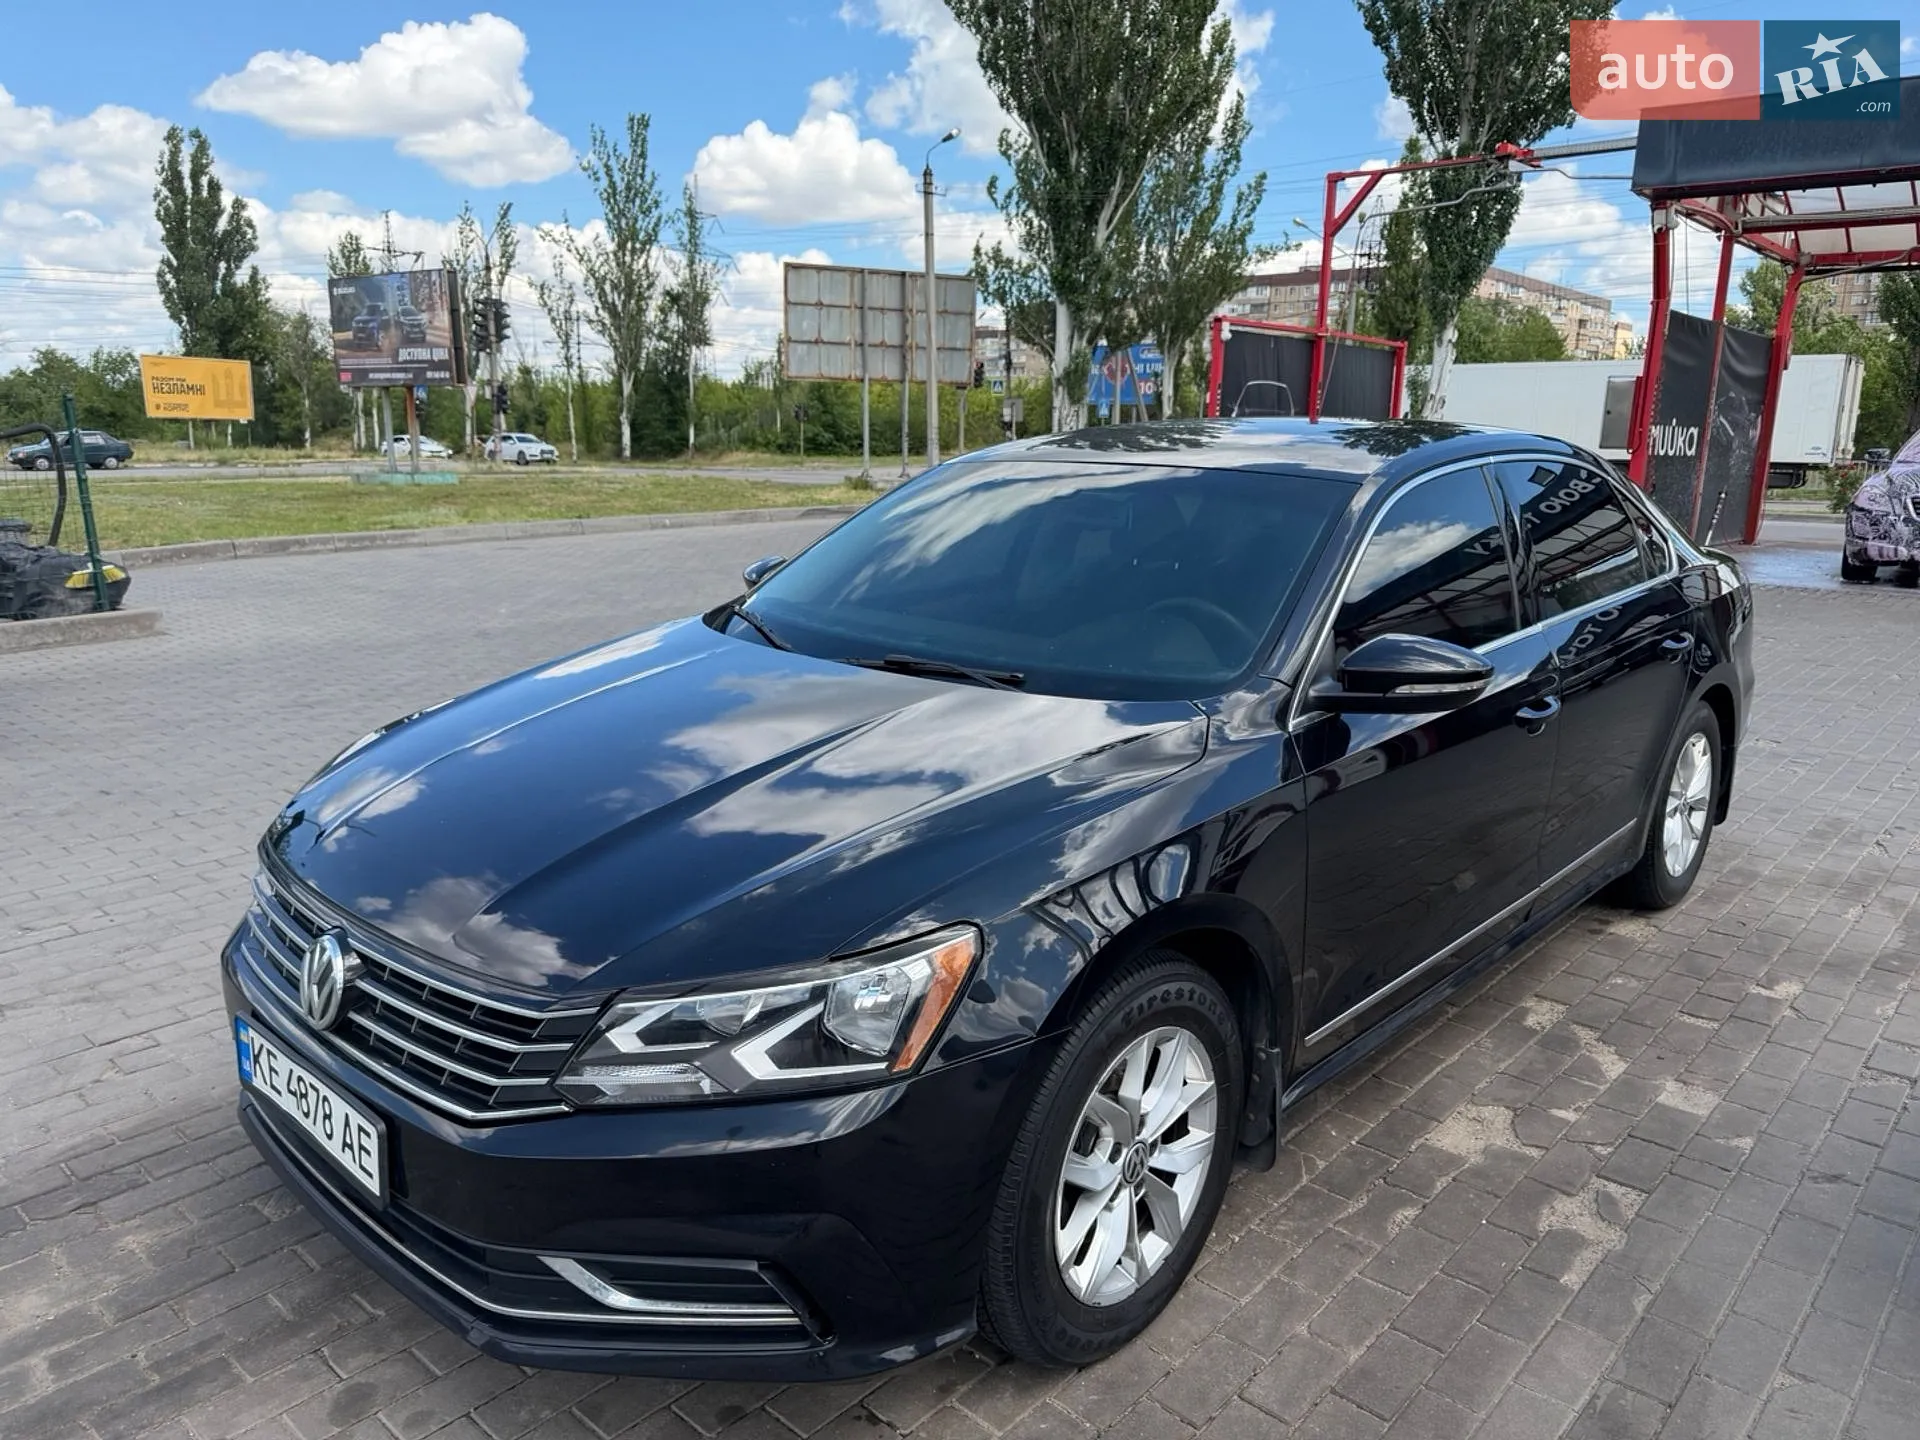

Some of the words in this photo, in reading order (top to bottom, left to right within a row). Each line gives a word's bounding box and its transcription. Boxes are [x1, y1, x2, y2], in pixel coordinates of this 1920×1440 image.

[152, 382, 206, 396] НЕЗЛАМНІ
[251, 1036, 283, 1097] KE
[287, 1068, 334, 1141] 4878
[342, 1112, 374, 1180] AE
